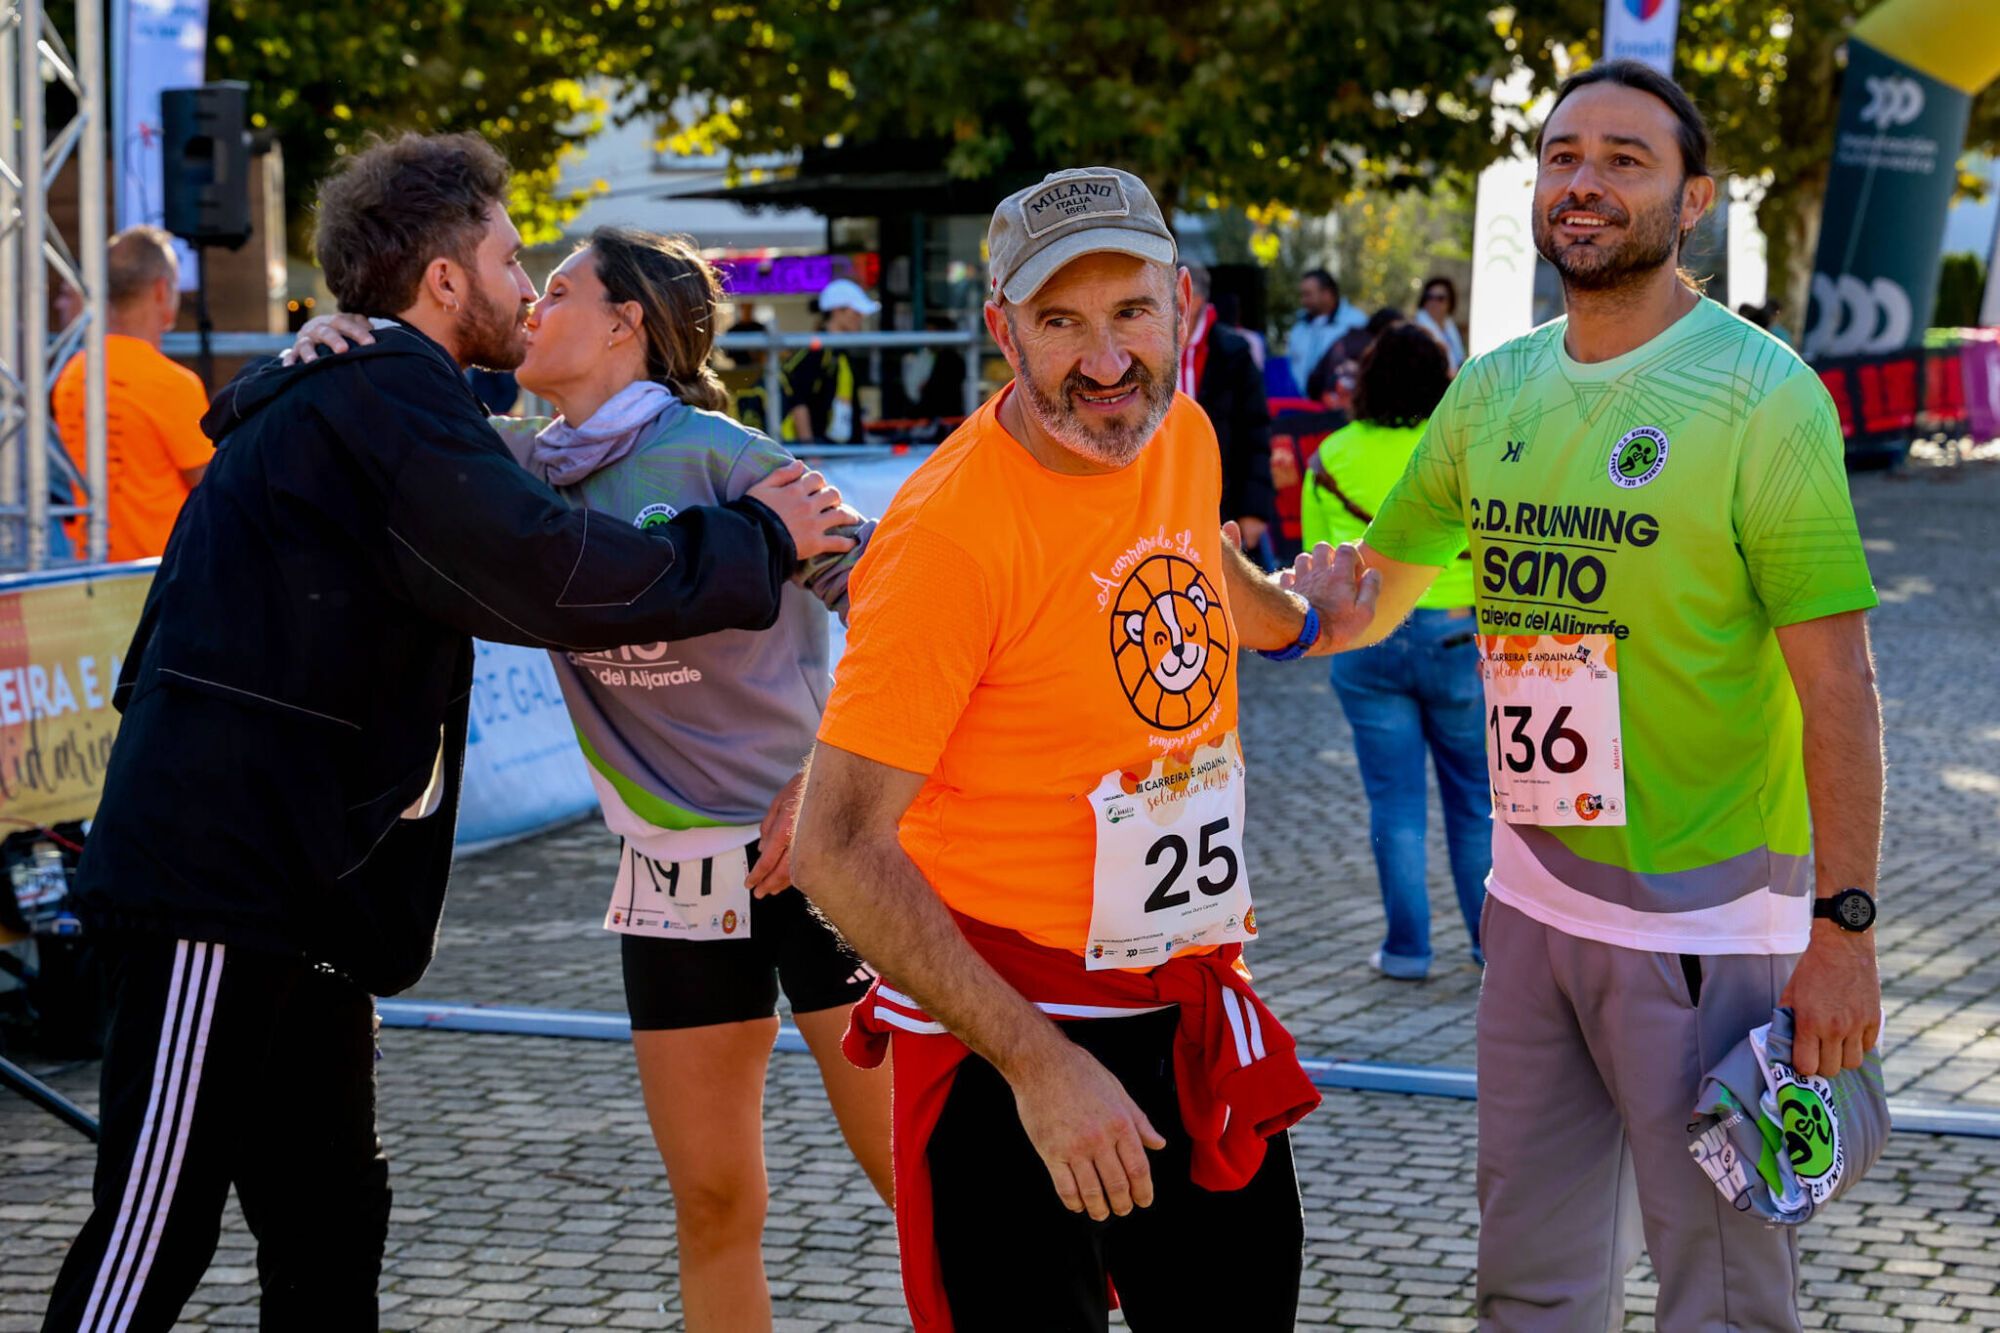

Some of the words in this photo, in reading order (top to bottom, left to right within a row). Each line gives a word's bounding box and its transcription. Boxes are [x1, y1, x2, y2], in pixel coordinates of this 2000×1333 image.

[1031, 183, 1112, 214] MILANO
[1056, 196, 1092, 210] ITALIA
[1065, 205, 1087, 215] 1861
[1483, 546, 1607, 604] sano
[1525, 609, 1550, 630] del
[1528, 652, 1532, 662] E
[1534, 652, 1576, 662] ANDAINA
[0, 662, 80, 727] EIRA
[79, 655, 104, 710] E
[508, 662, 563, 714] GAL
[600, 667, 627, 686] del
[630, 666, 702, 690] Aljarafe
[1490, 704, 1588, 773] 136
[1144, 772, 1190, 792] CARREIRA
[1190, 767, 1196, 777] E
[1197, 756, 1227, 774] ANDAINA
[1147, 782, 1201, 812] solidaria
[1144, 817, 1238, 913] 25
